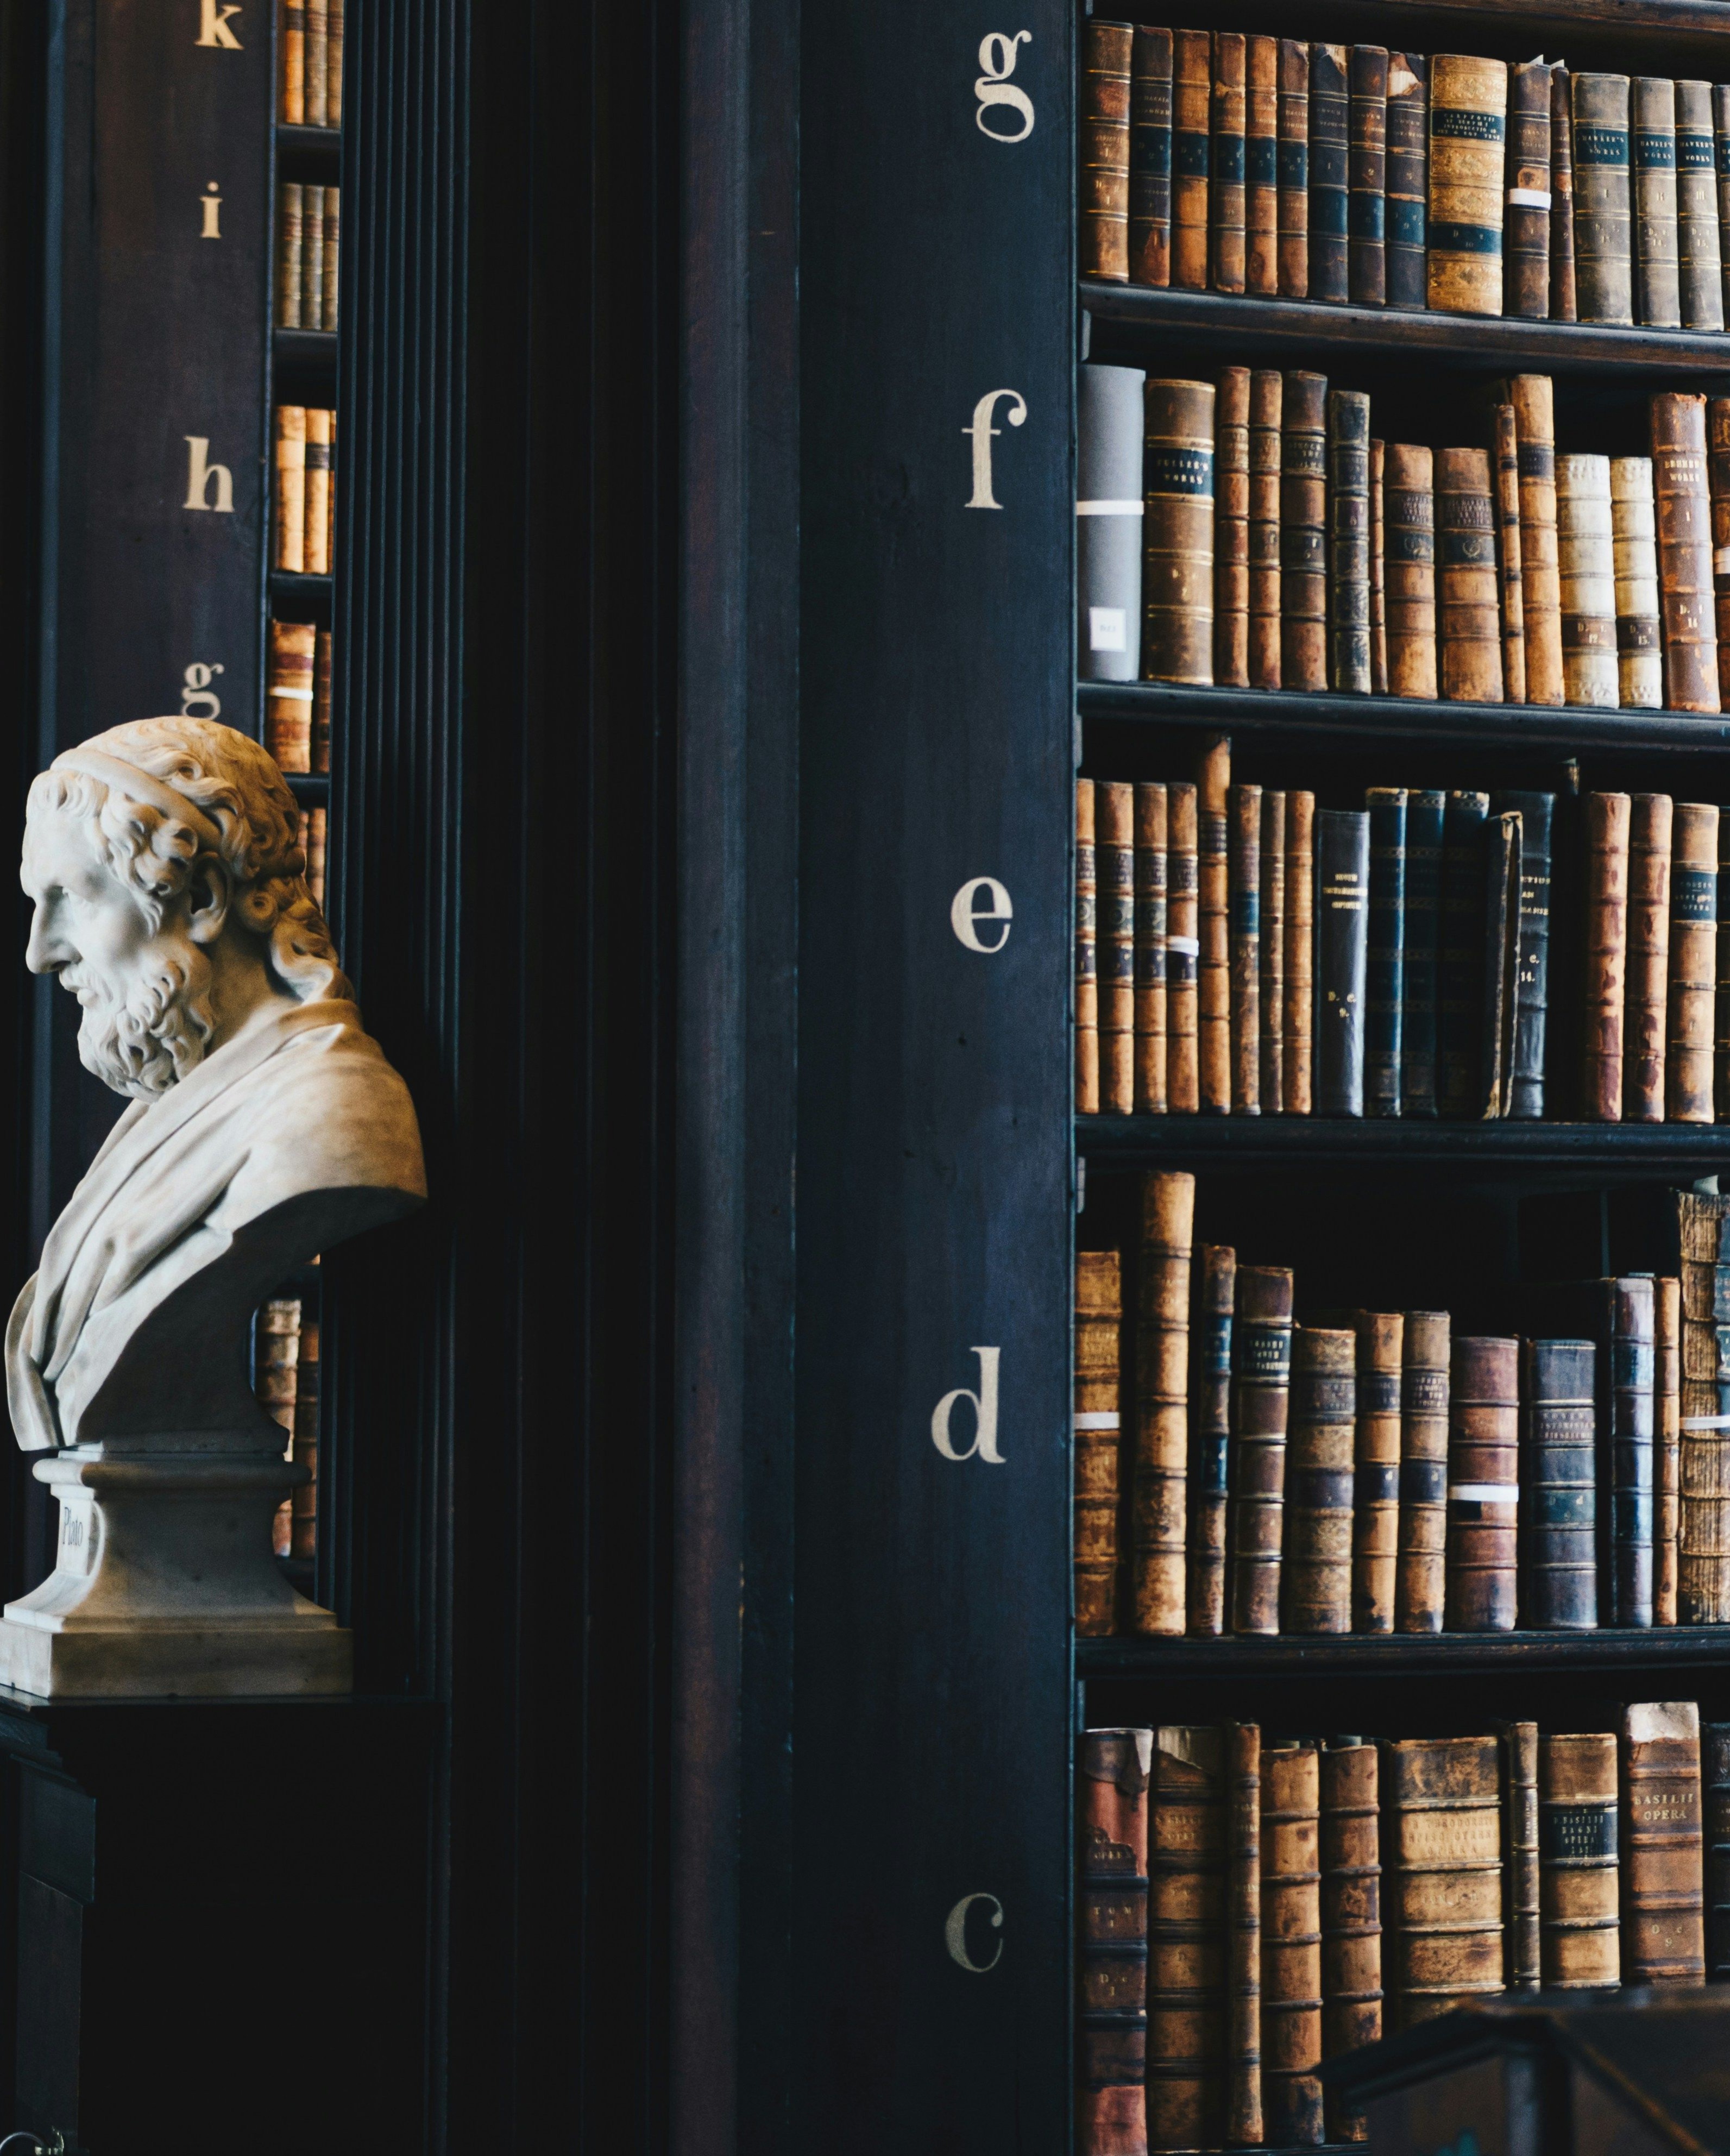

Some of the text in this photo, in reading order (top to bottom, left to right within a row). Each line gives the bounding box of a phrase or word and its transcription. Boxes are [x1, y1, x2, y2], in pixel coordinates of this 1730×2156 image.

[196, 0, 243, 49] k
[974, 30, 1035, 143] g
[200, 181, 222, 238] i
[184, 436, 234, 513] h
[961, 389, 1027, 510] f
[181, 662, 224, 721] g
[951, 877, 1013, 953] e
[931, 1346, 1006, 1463] d
[62, 1506, 83, 1547] Plato
[1633, 1793, 1694, 1806] BASILII
[1644, 1809, 1687, 1821] OPERA
[945, 1893, 1003, 1973] c
